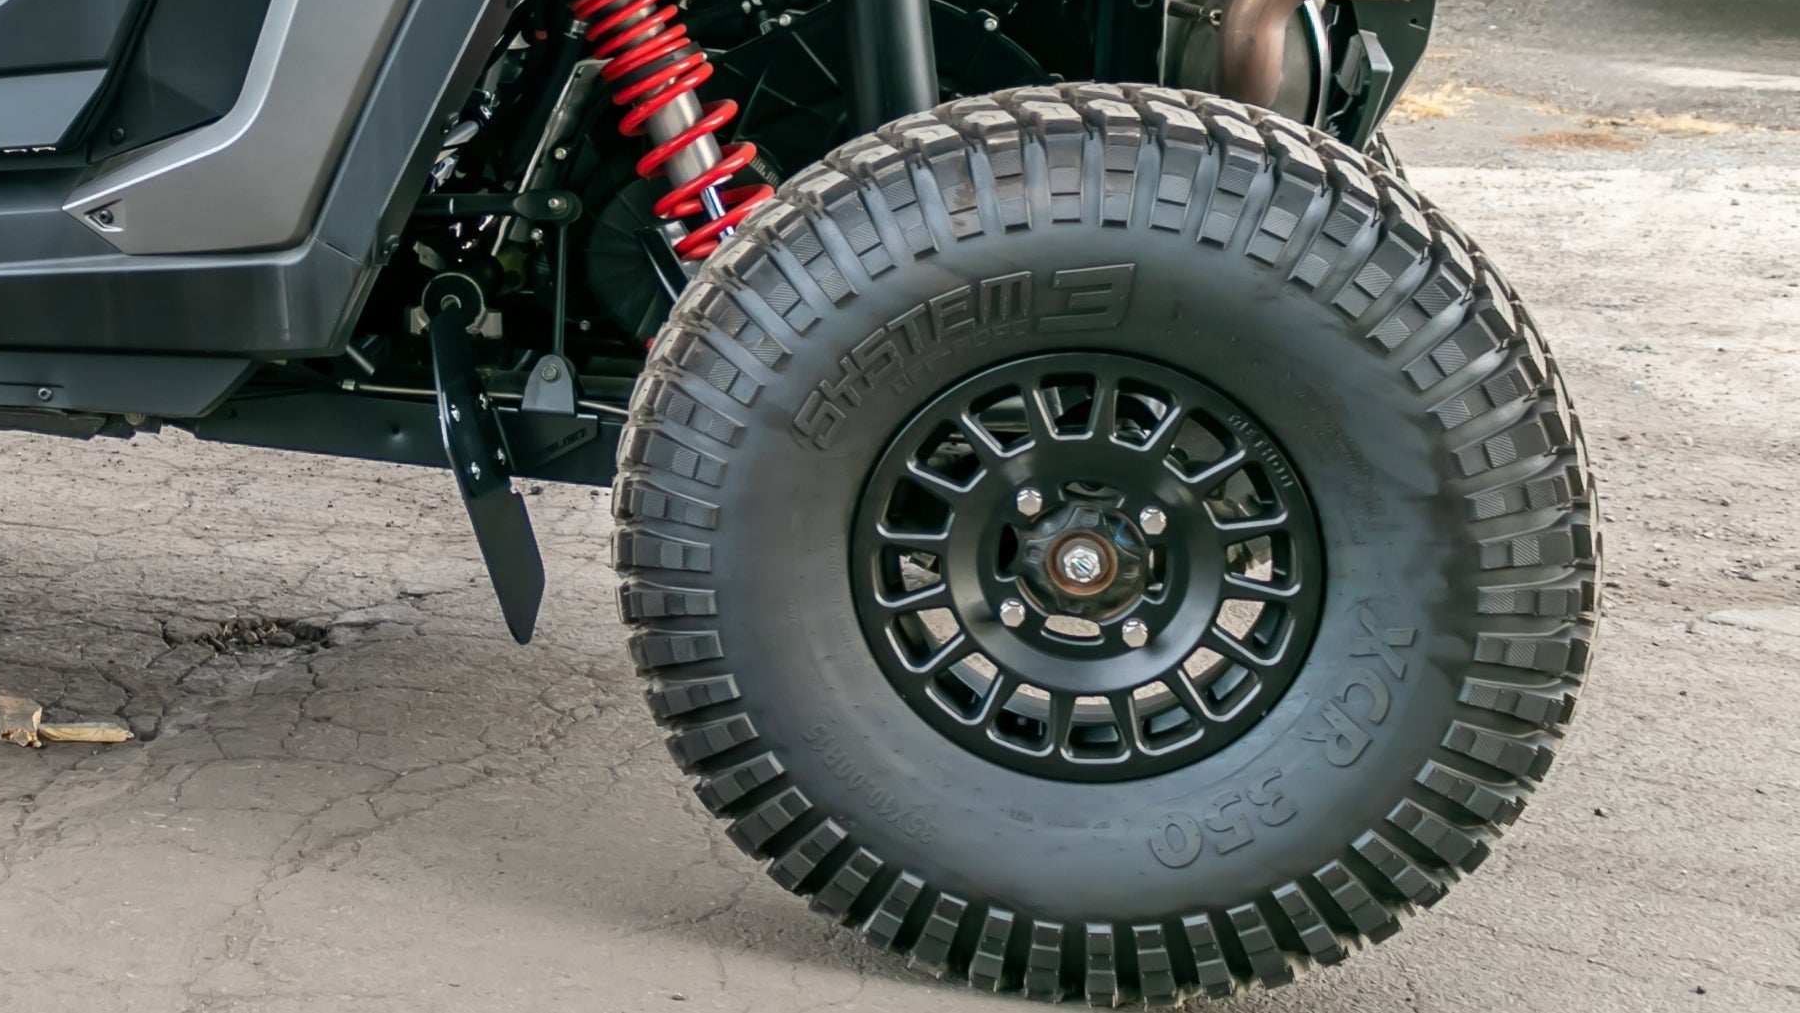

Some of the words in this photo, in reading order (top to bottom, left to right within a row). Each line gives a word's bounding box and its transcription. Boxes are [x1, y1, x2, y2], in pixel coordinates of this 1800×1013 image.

[792, 271, 1033, 451] SYSTEM
[1037, 263, 1137, 333] 3
[1300, 598, 1417, 768] XCR
[1149, 766, 1298, 869] 350
